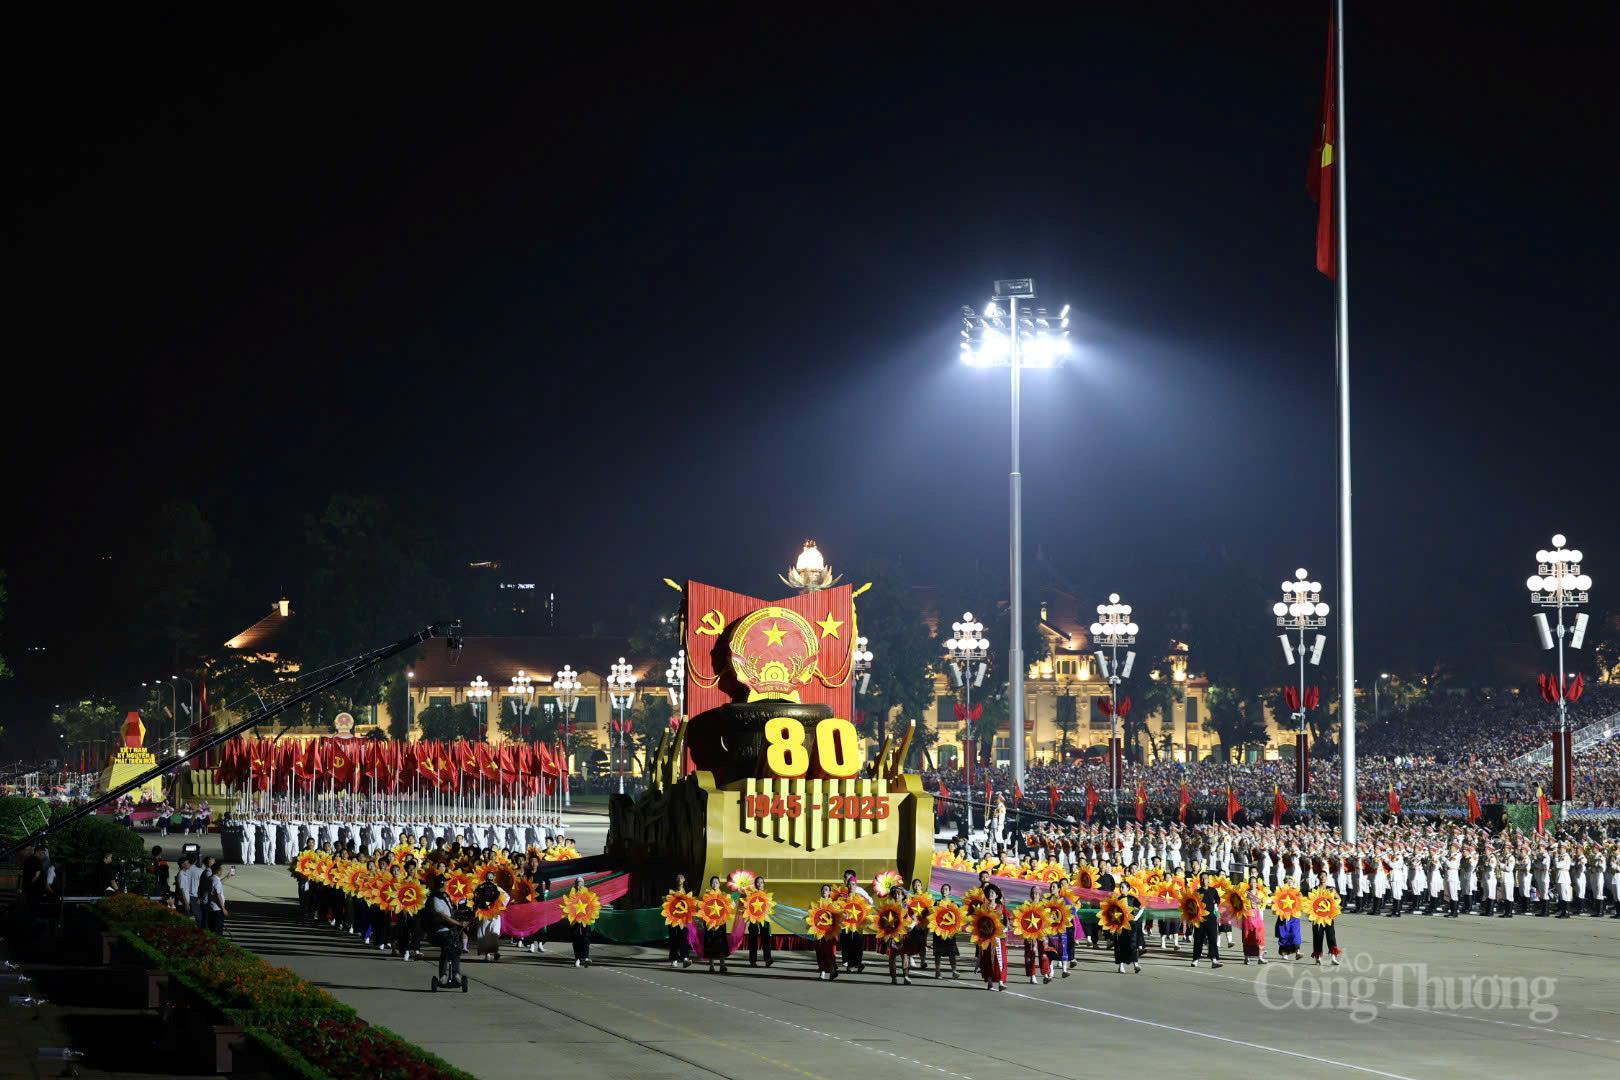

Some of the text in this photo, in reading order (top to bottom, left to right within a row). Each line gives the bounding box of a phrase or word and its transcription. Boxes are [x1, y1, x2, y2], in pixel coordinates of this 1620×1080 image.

[764, 717, 863, 777] 80
[745, 794, 801, 818] 1945
[828, 795, 889, 819] 2025
